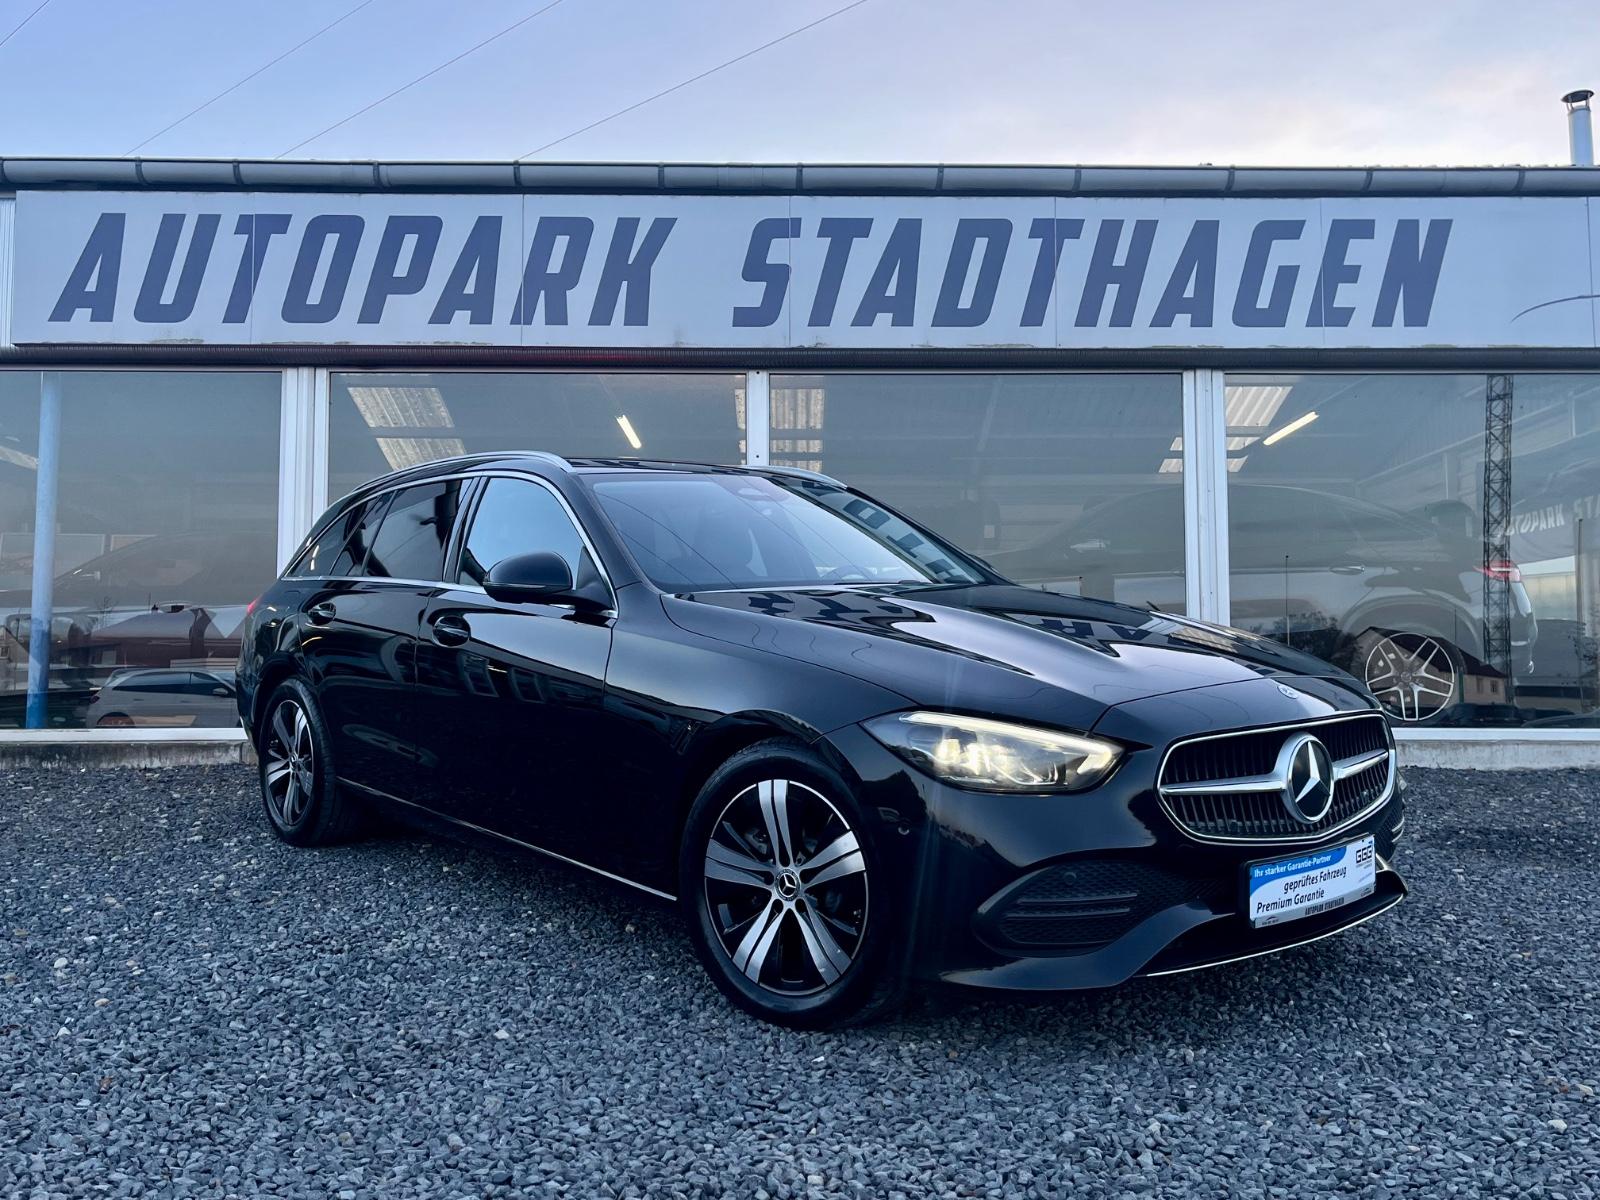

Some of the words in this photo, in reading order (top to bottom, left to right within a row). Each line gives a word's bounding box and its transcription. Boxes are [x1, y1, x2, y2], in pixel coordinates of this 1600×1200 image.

[48, 212, 678, 327] AUTOPARK
[732, 217, 1453, 328] STADTHAGEN
[1497, 503, 1566, 537] UTOPARK
[1254, 869, 1263, 878] Ihr
[1265, 863, 1287, 876] starker
[1287, 855, 1332, 871] Garantie-Partner
[1284, 875, 1319, 894] geprüftes
[1319, 866, 1347, 882] Fahrzeug
[1256, 897, 1292, 914] Premium
[1294, 887, 1325, 905] Garantie
